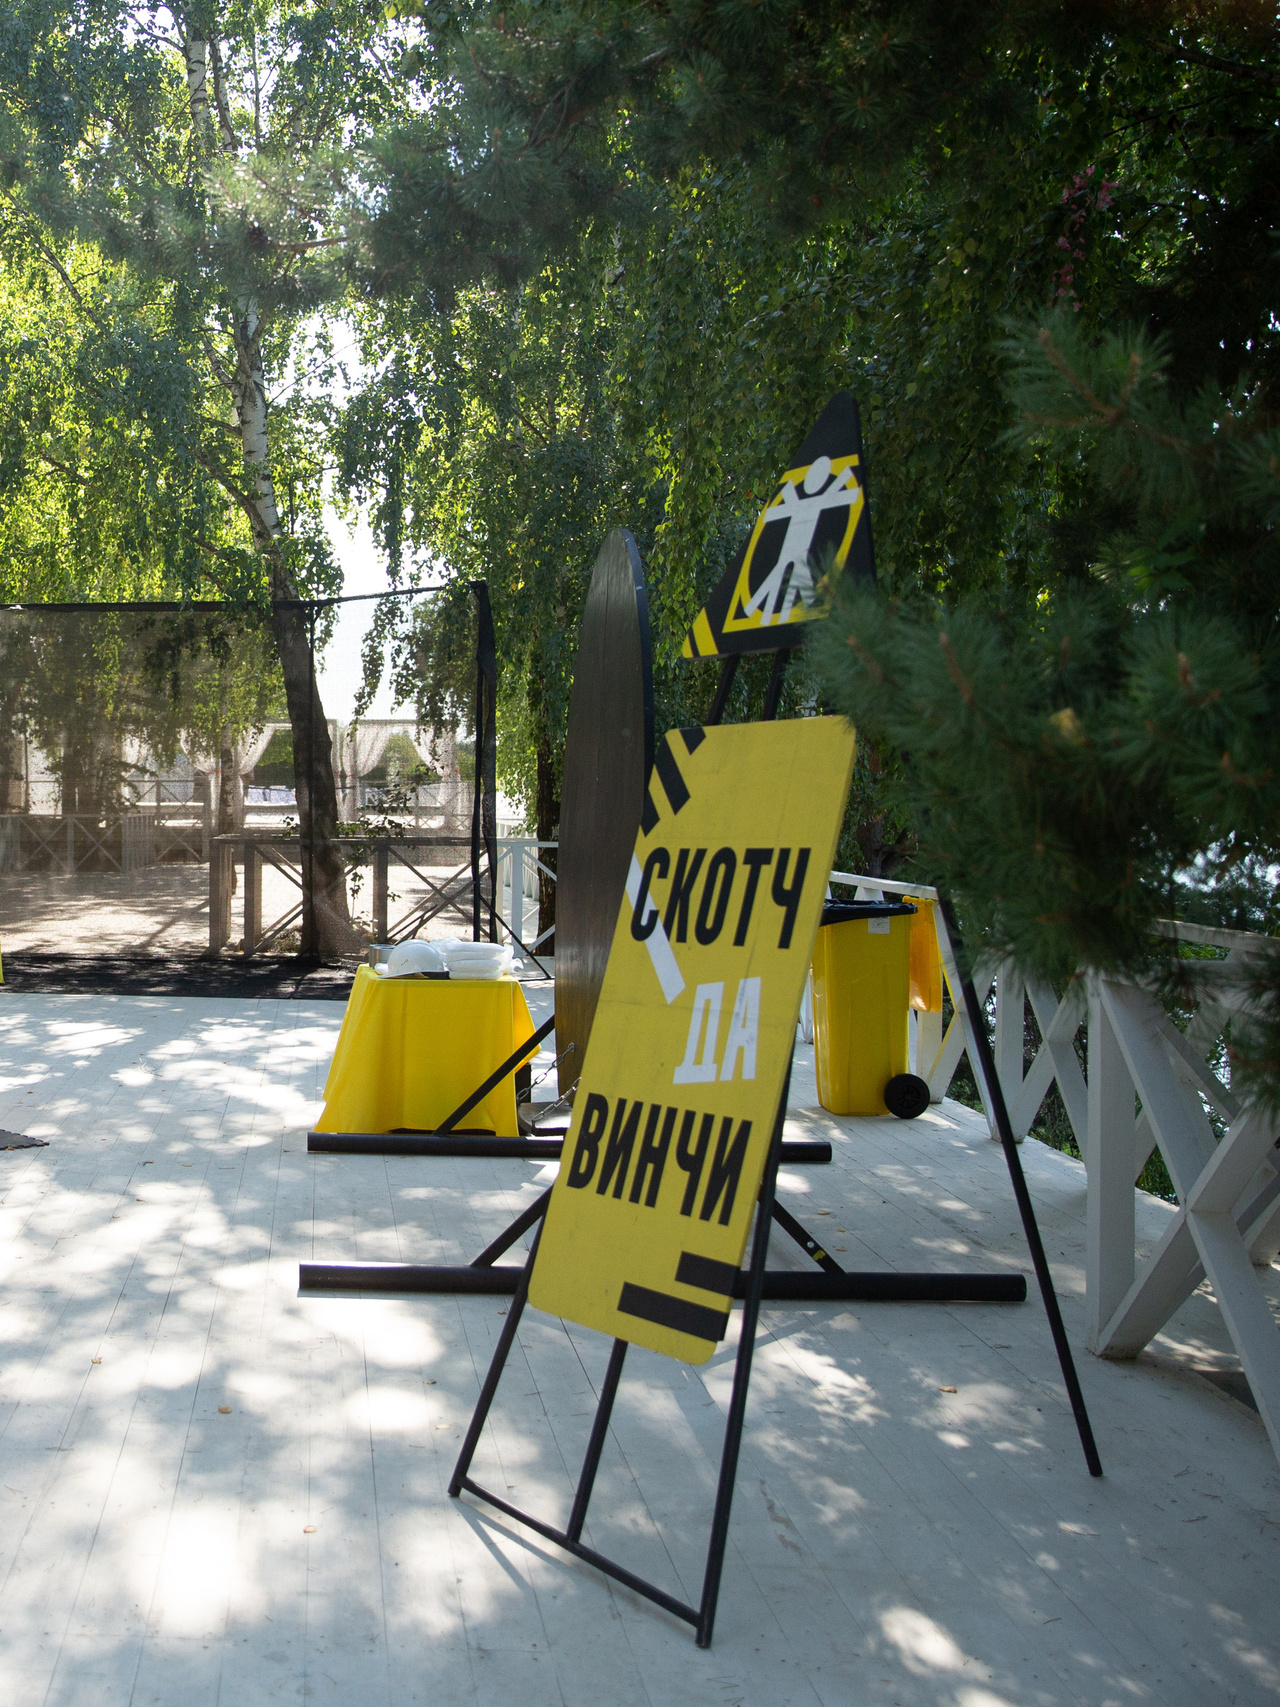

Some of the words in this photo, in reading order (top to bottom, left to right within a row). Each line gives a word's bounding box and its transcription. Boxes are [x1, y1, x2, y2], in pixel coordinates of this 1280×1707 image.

[630, 846, 811, 950] СКОТЧ
[673, 977, 761, 1085] ДА
[566, 1092, 753, 1226] ВИНЧИ
